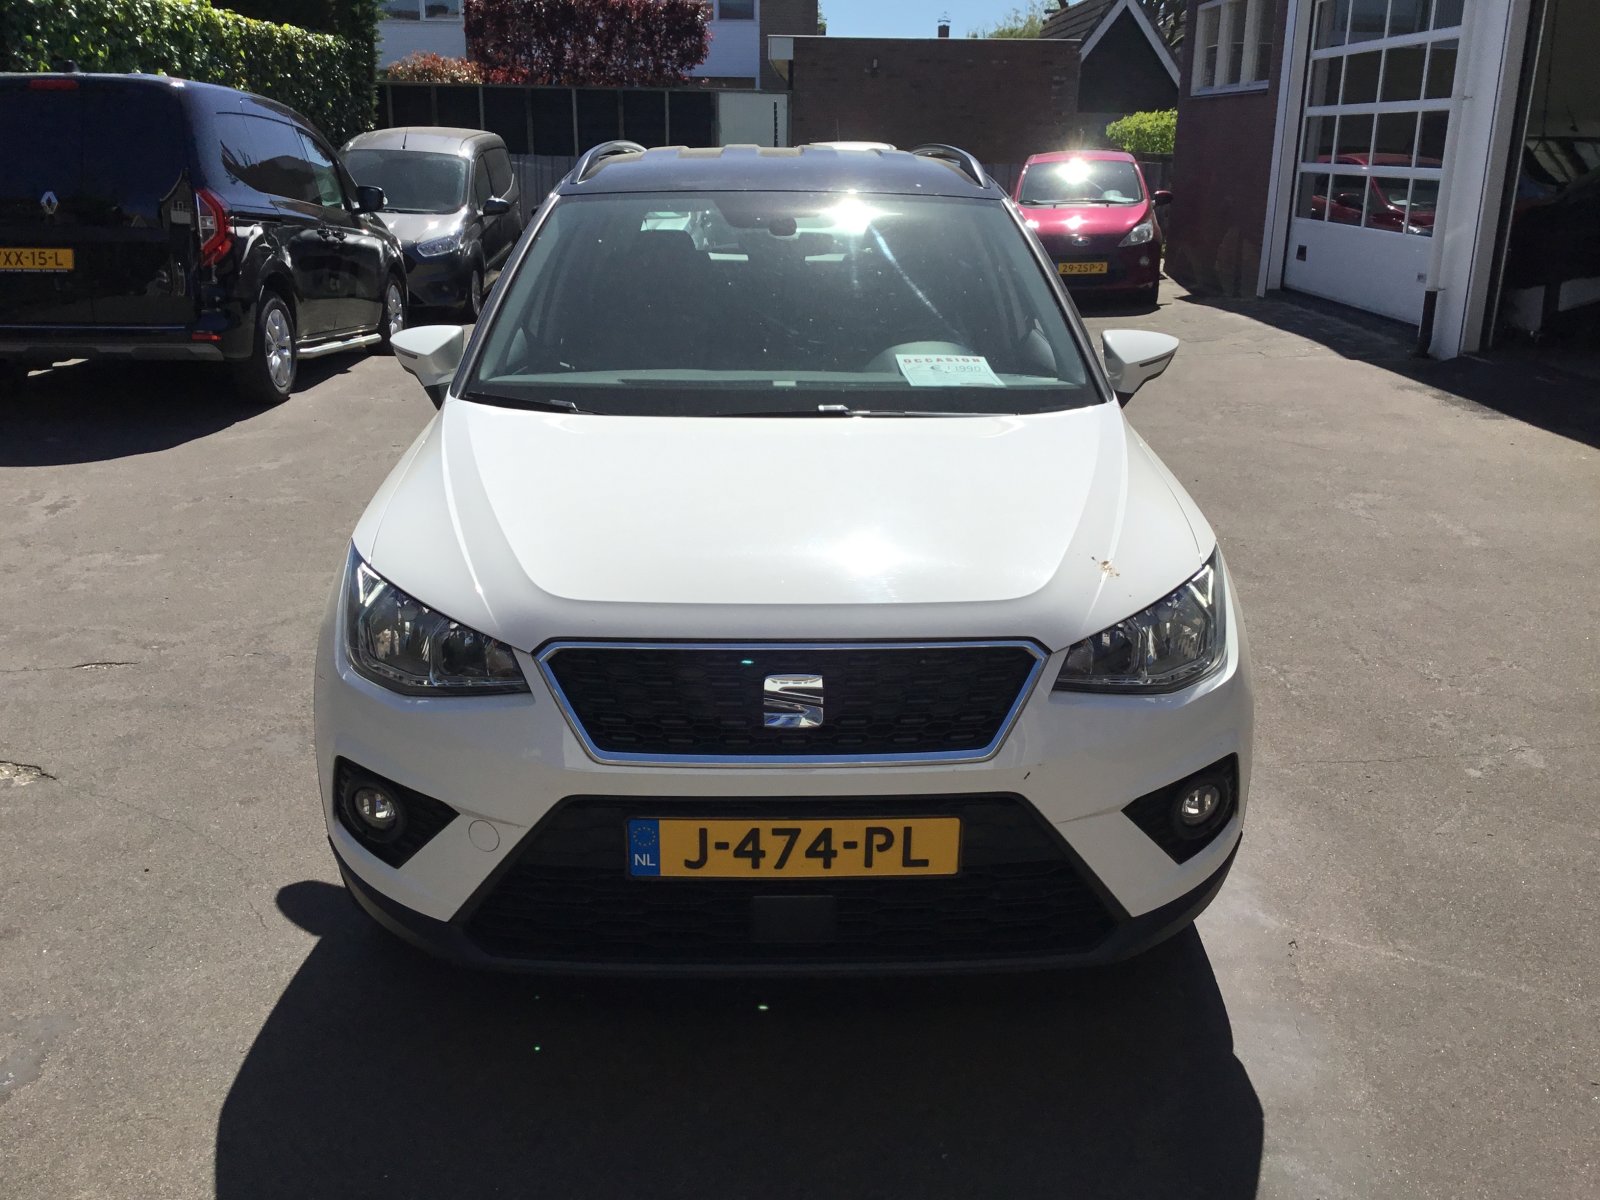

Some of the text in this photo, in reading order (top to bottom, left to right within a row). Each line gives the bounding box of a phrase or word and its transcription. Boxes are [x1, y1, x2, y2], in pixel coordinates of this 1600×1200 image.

[0, 251, 64, 266] XX-15-L
[1062, 263, 1105, 273] 29-ZSP-2
[634, 826, 930, 870] NL J-474-PL
